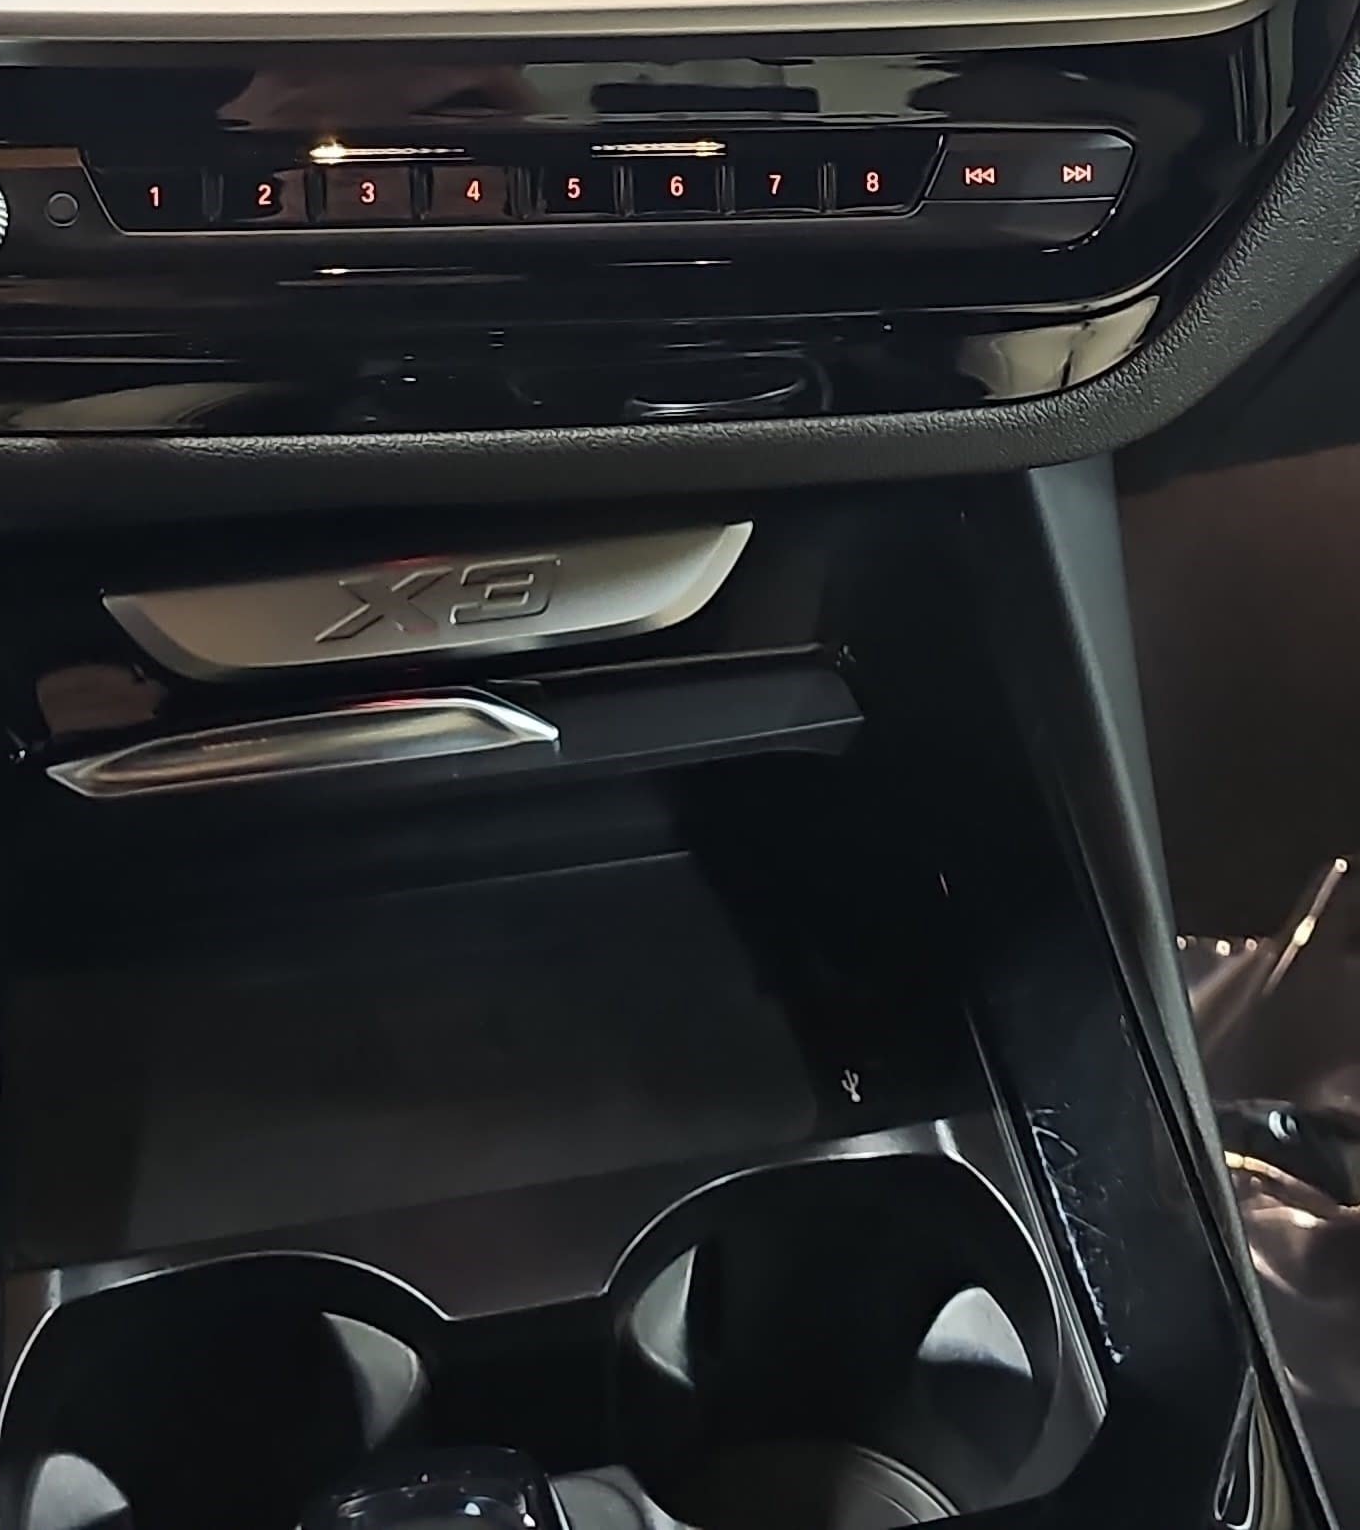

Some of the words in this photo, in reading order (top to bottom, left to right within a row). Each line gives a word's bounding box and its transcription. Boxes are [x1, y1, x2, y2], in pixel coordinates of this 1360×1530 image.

[258, 183, 272, 206] 2
[361, 181, 376, 204] 3
[466, 179, 481, 201] 4
[567, 177, 580, 199] 5
[670, 175, 684, 198] 6
[770, 174, 782, 196] 7
[866, 172, 880, 194] 8
[149, 185, 161, 208] 1
[315, 553, 560, 643] X3
